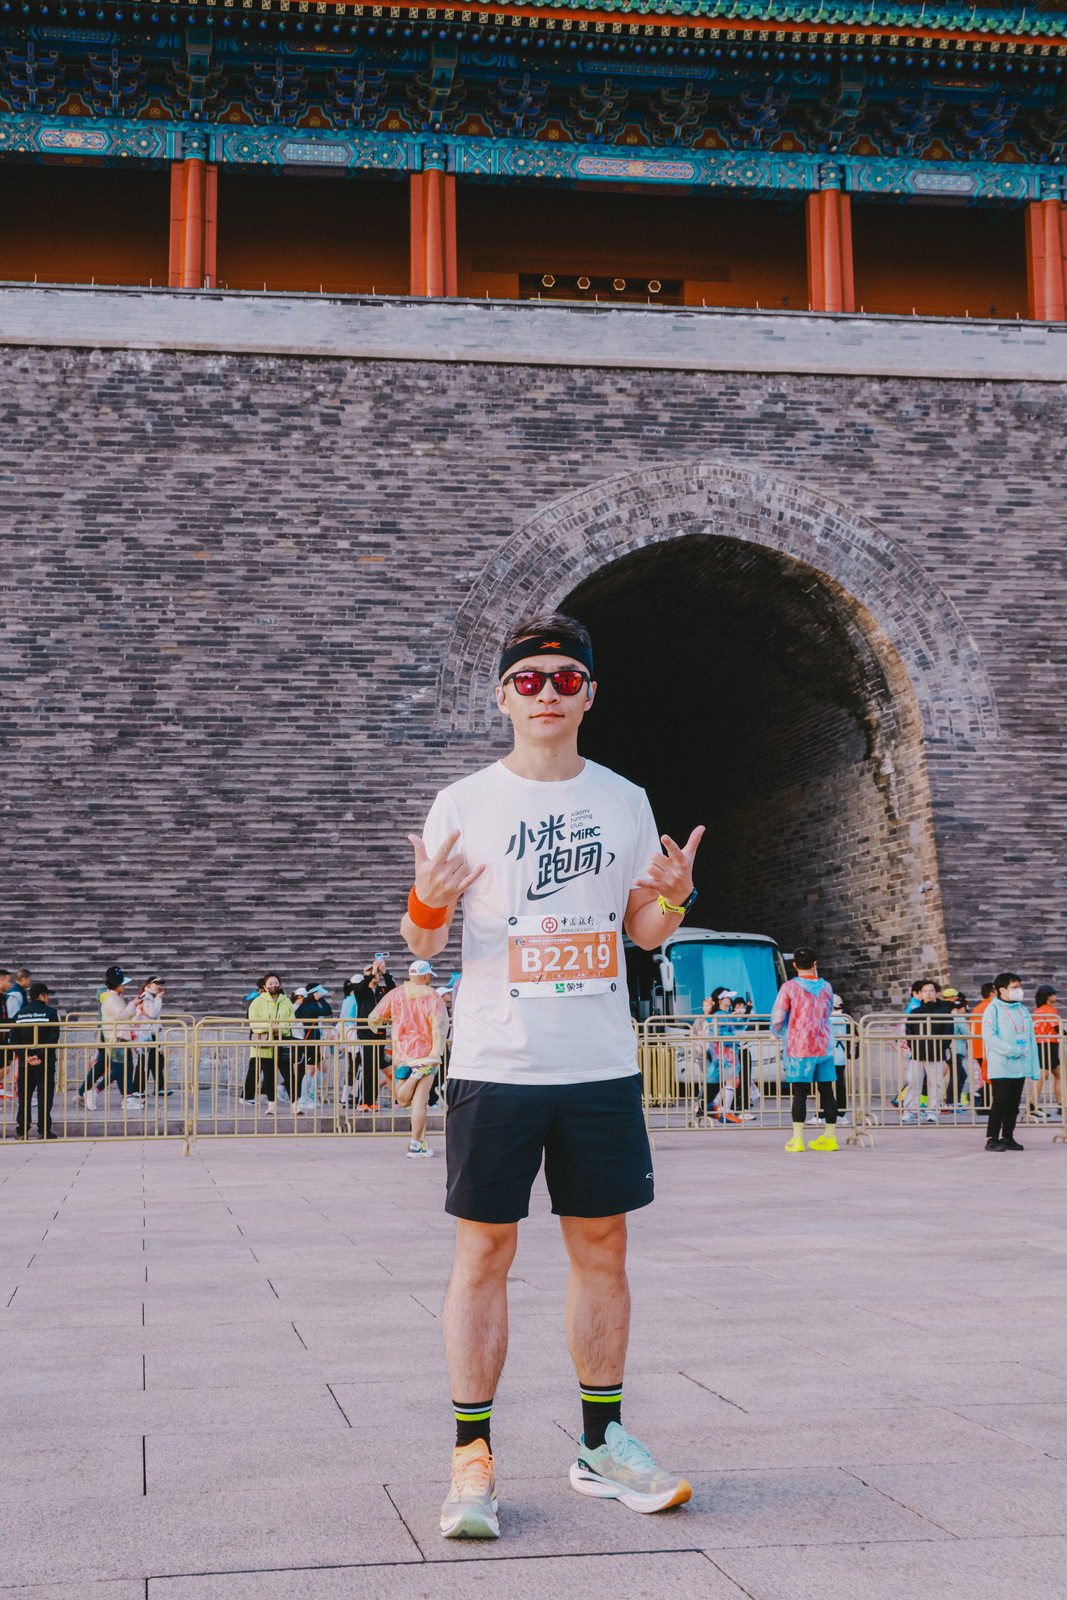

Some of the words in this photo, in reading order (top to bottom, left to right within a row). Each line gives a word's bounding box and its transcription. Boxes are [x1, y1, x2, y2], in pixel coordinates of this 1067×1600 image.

[570, 813, 593, 823] running
[571, 809, 590, 817] xiaomi
[570, 821, 584, 829] club
[570, 825, 601, 842] MiRC
[504, 813, 567, 861] 小米
[536, 841, 602, 890] 跑团
[521, 943, 610, 973] B2219
